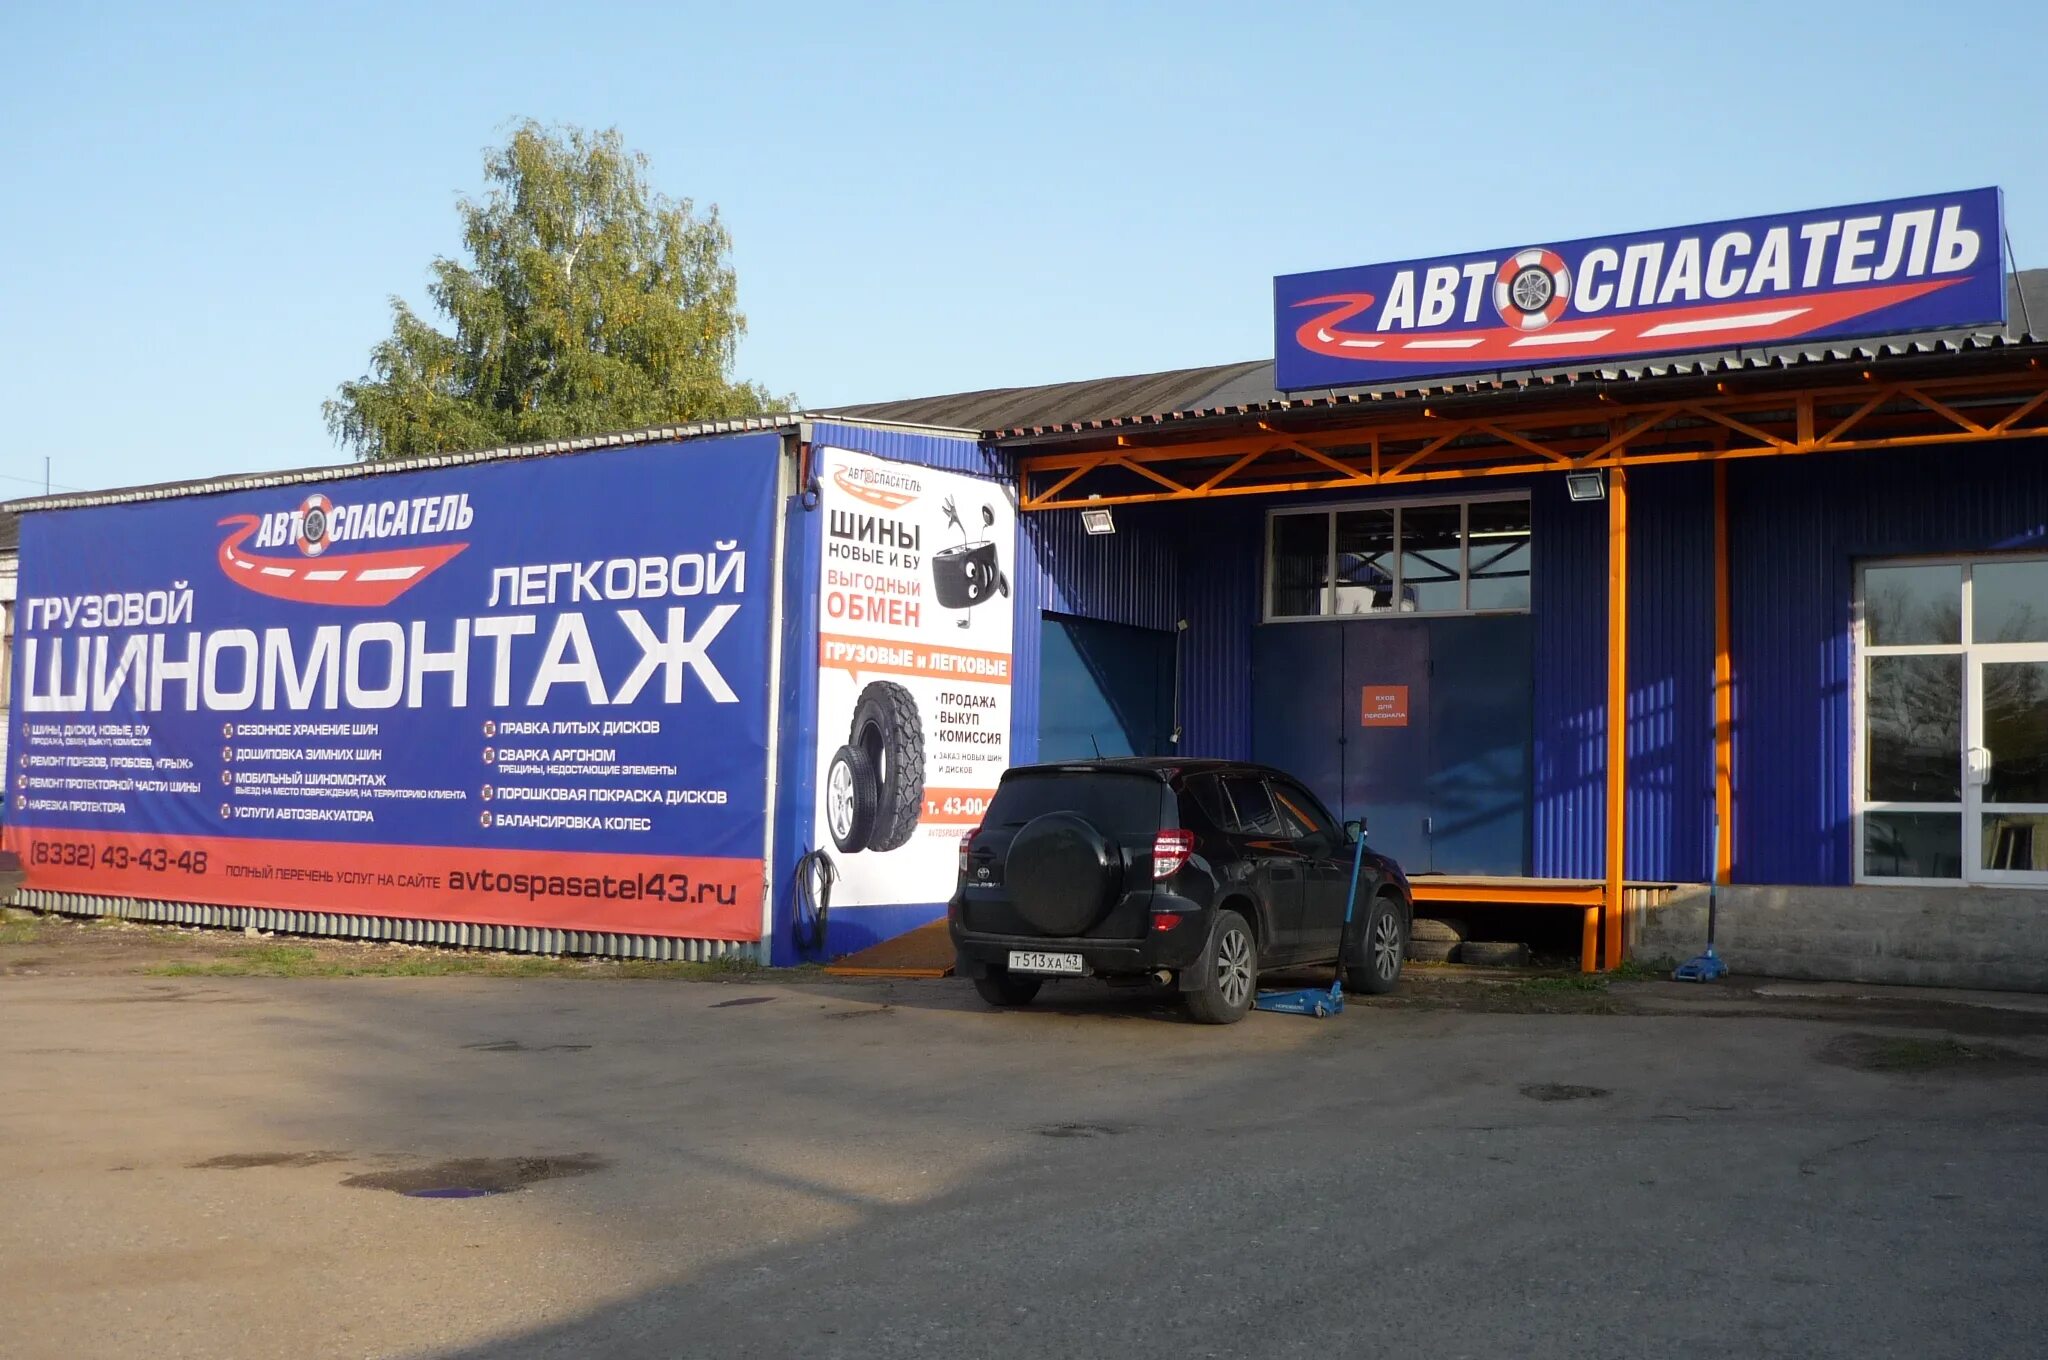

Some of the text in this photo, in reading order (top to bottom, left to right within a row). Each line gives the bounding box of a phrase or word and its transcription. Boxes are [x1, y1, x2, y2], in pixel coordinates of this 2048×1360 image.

[1376, 204, 1980, 331] АВТОСПАСАТЕЛЬ
[848, 467, 921, 492] АВТОСПАСАТЕЛЬ
[255, 493, 474, 555] АВТОСПАСАТЕЛЬ
[830, 509, 920, 551] ШИНЫ
[828, 542, 920, 570] НОВЫЕ И БУ
[488, 540, 747, 607] ЛЕГКОВОЙ
[828, 569, 921, 597] ВЫГОДНЫЙ
[27, 580, 194, 630] ГРУЗОВОЙ
[827, 591, 920, 628] ОБМЕН
[23, 604, 741, 712] ШИНОМОНТАЖ
[824, 641, 914, 667] ГРУЗОВЫЕ
[929, 652, 1008, 677] ЛЕГКОВЫЕ
[940, 692, 996, 709] ПРОДАЖА
[940, 711, 980, 726] ВЫКУП
[32, 725, 150, 737] ШИНЫ, ДИСКИ, НОВЫЕ, Б/У
[237, 723, 379, 736] СЕЗОННОЕ ХРАНЕНИЕ ШИН
[500, 721, 660, 736] ПРАВКА ЛИТЫХ ДИСКОВ
[112, 738, 152, 746] КОМИССИЯ
[939, 730, 1002, 745] КОМИССИЯ
[236, 748, 382, 761] ДОШИПОВКА ЗИМНИХ ШИН
[499, 749, 616, 762] СВАРКА АРГОНОМ
[939, 752, 1003, 763] ЗАКАЗ НОВЫХ ШИН
[30, 755, 65, 767] РЕМОНТ
[66, 756, 108, 770] ПОРЕЗОВ,
[110, 757, 154, 771] ПРОБОЕВ,
[498, 764, 677, 776] ТРЕЩИНЫ, НЕДОСТАЮЩИЕ ЭЛЕМЕНТЫ
[945, 766, 973, 775] ДИСКОВ
[29, 777, 201, 793] РЕМОНТ ПРОТЕКТОРНОЙ ЧАСТИ ШИНЫ
[235, 771, 387, 786] МОБИЛЬНЫЙ ШИНОМОНТАЖ
[235, 786, 466, 799] ВЫЕЗД НА МЕСТО ПОВРЕЖДЕНИЯ, НА ТЕРРИТОРИЮ КЛИЕНТА
[497, 787, 727, 805] ПОРОШКОВАЯ ПОКРАСКА ДИСКОВ
[29, 799, 126, 814] НАРЕЗКА ПРОТЕКТОРА
[234, 806, 374, 822] УСЛУГИ АВТОЭВАКУАТОРА
[496, 815, 652, 831] БАЛАНСИРОВКА КОЛЕС
[30, 840, 208, 875] (8332) 43-43-48
[225, 864, 441, 889] ПОЛНЫЙ ПЕРЕЧЕНЬ УСЛУГ НА САЙТЕ
[449, 869, 737, 906] avtospasatel43.ru
